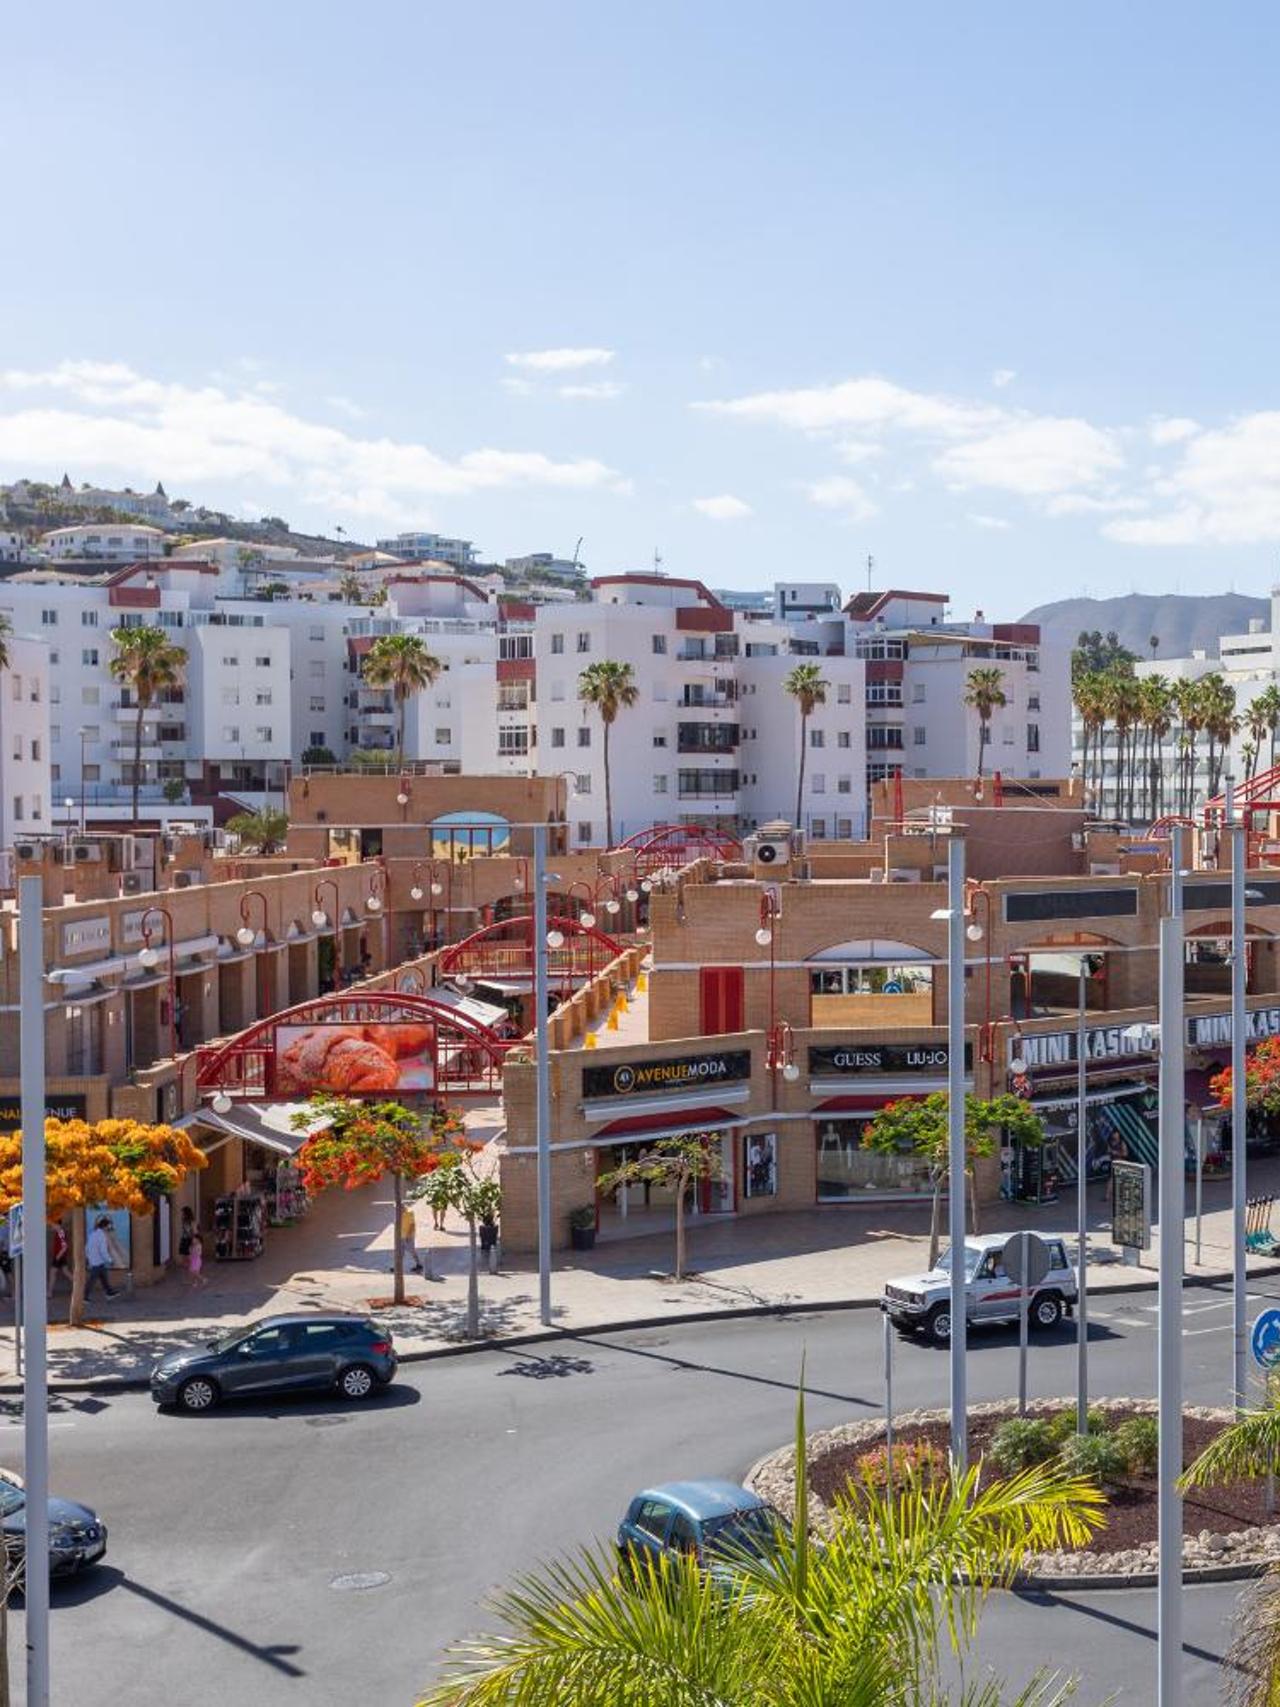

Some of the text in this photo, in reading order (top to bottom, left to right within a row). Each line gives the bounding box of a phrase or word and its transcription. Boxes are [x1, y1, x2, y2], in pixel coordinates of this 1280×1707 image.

[1197, 1015, 1233, 1043] MIN
[834, 1052, 882, 1067] GUESS
[1023, 1033, 1070, 1066] MINI
